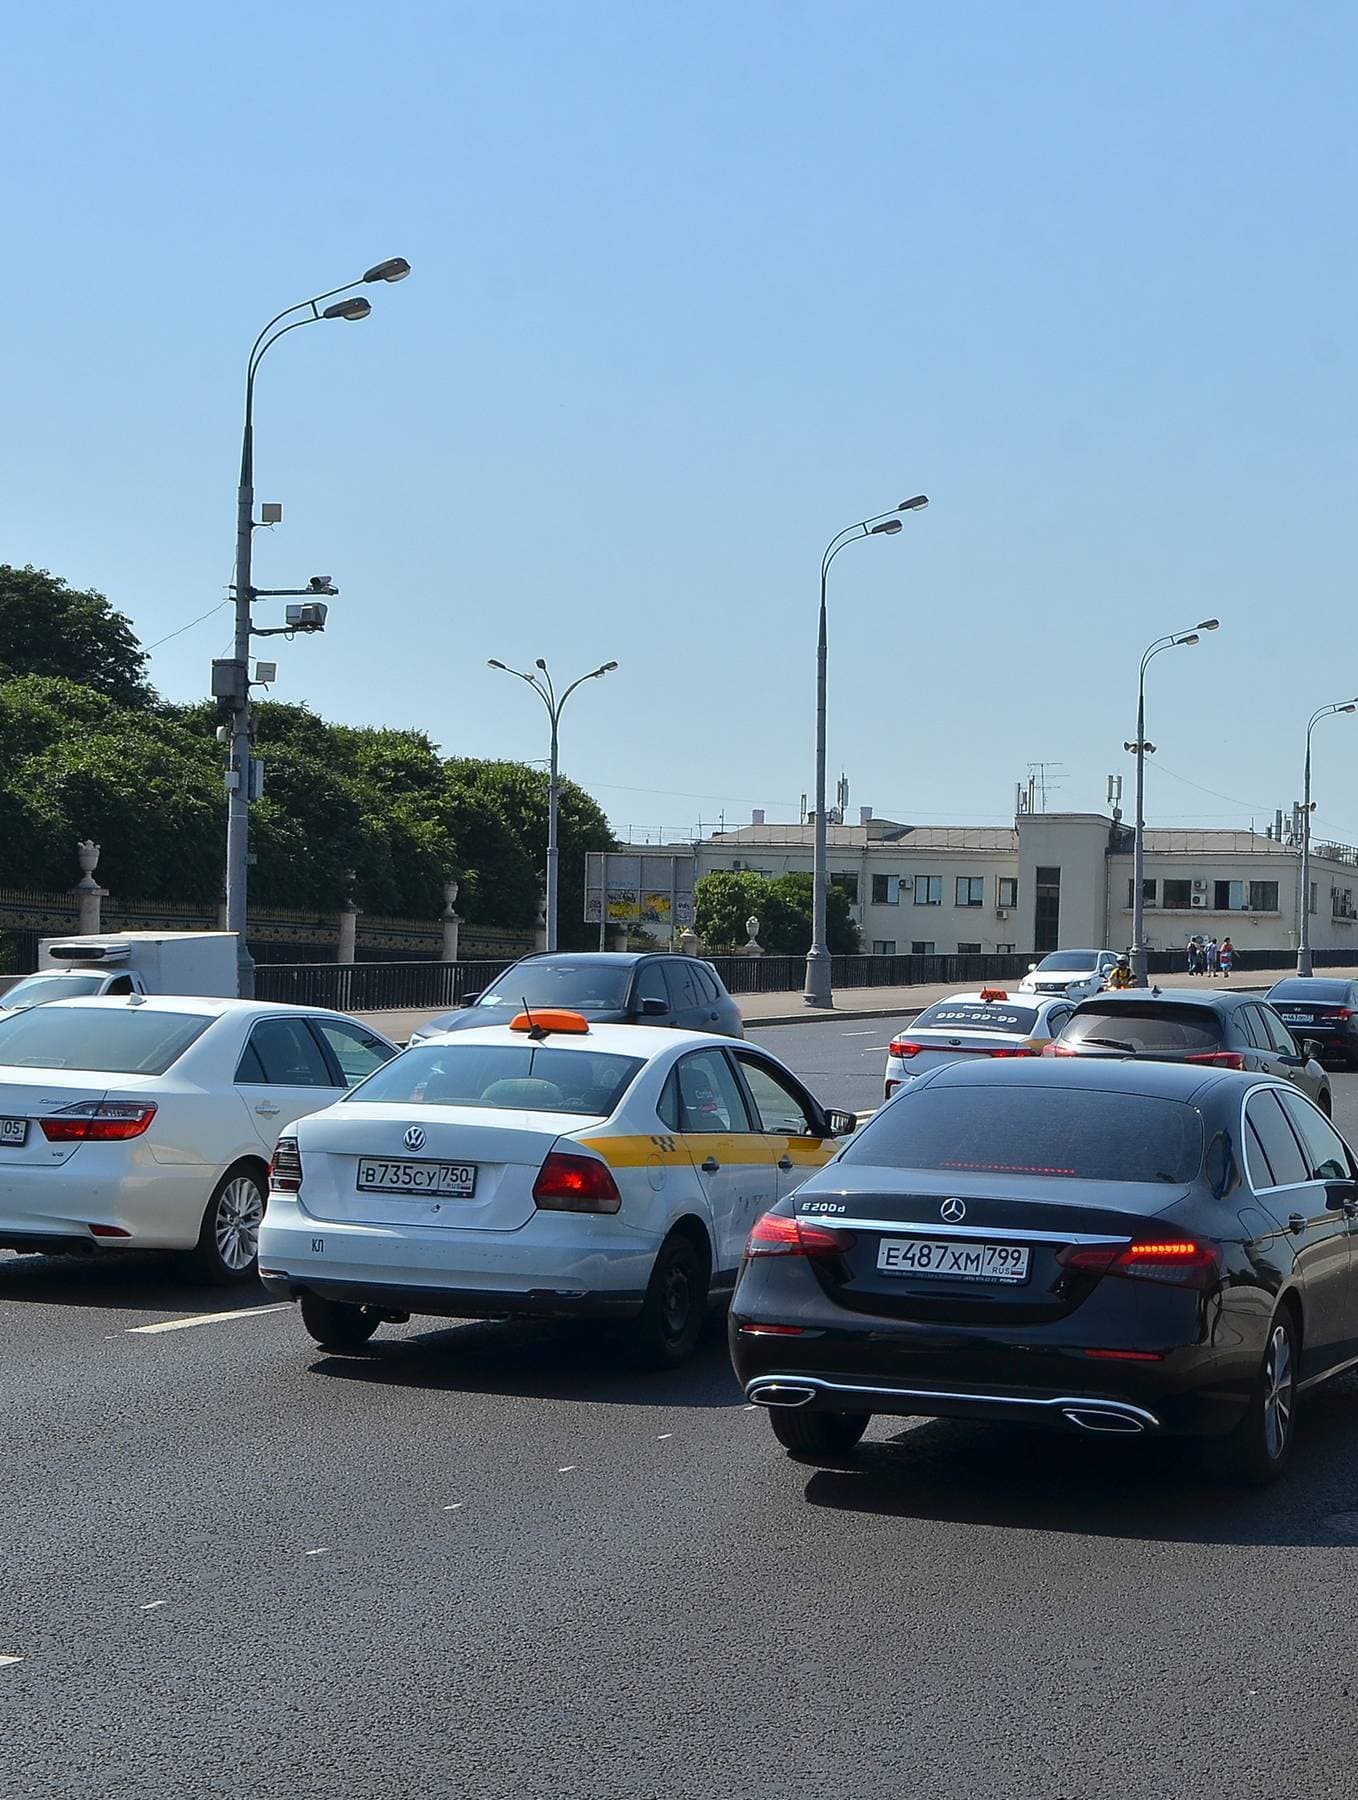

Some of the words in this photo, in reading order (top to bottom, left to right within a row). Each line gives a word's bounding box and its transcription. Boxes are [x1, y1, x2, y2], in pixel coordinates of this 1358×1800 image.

[935, 1012, 1018, 1024] 999-99-99
[4, 1121, 20, 1135] 05
[441, 1166, 470, 1184] 750
[311, 1238, 324, 1252] КЛ
[986, 1247, 1022, 1267] 799
[992, 1266, 1010, 1275] RUS
